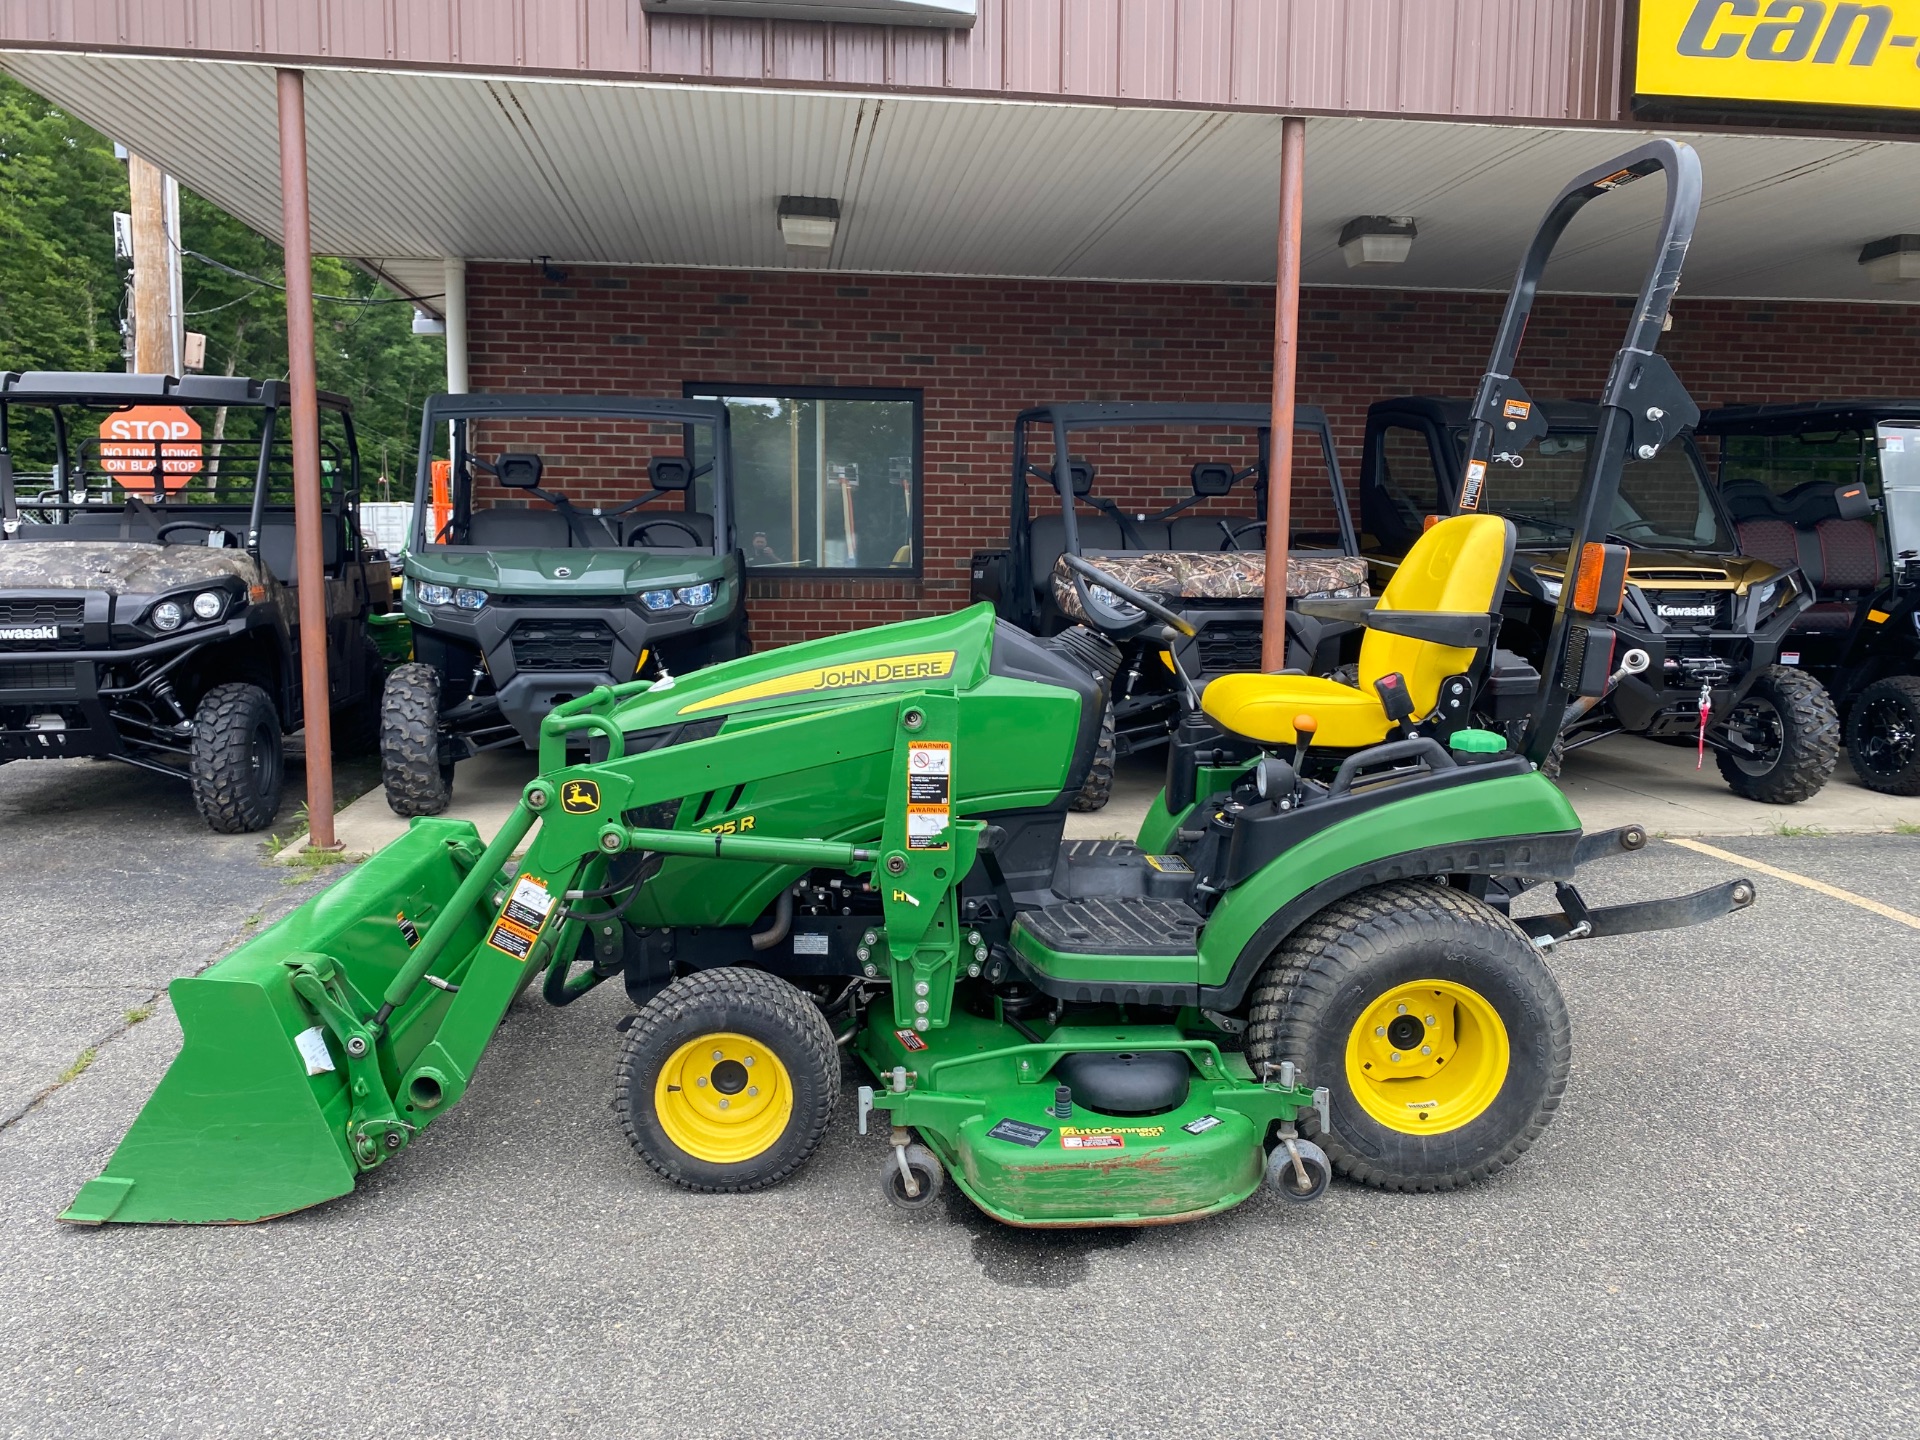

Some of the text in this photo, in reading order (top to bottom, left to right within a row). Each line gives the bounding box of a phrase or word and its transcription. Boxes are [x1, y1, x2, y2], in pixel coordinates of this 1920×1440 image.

[111, 420, 189, 440] STOP
[104, 448, 198, 457] NO UNLADING
[107, 460, 196, 472] ON BLAKTOP
[1657, 605, 1715, 616] Kawasaki
[0, 626, 58, 639] wasaki
[814, 661, 942, 688] JOHN DEERE
[915, 806, 948, 814] WARNING
[740, 816, 755, 832] R
[507, 924, 533, 941] WARNING
[1062, 1126, 1165, 1136] AutoConnect
